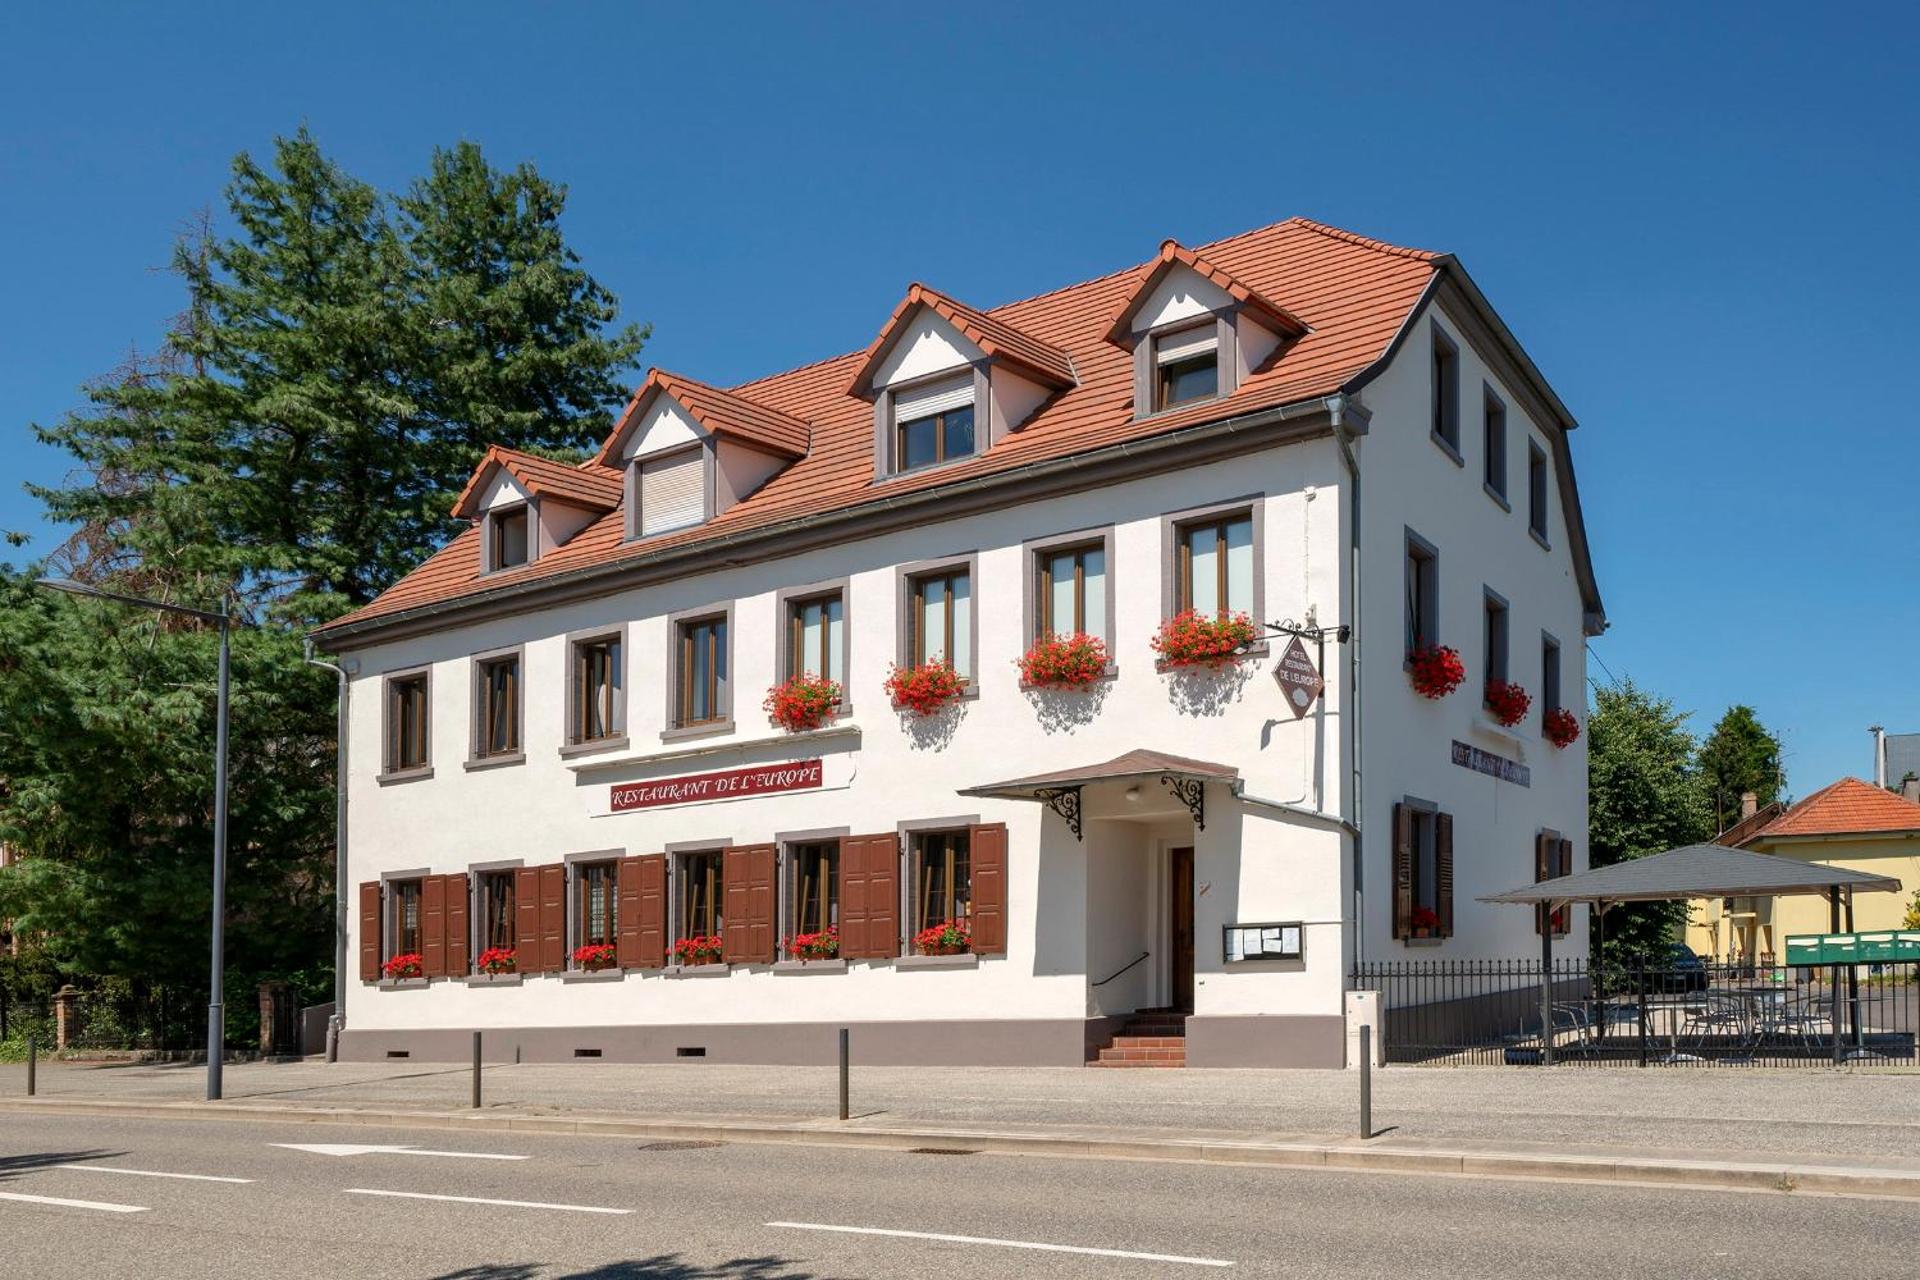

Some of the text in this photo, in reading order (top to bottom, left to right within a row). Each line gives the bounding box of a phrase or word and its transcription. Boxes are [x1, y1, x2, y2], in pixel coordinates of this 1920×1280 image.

[1279, 669, 1289, 681] DE
[611, 766, 821, 808] RESTAURANT DE L'EUROPE
